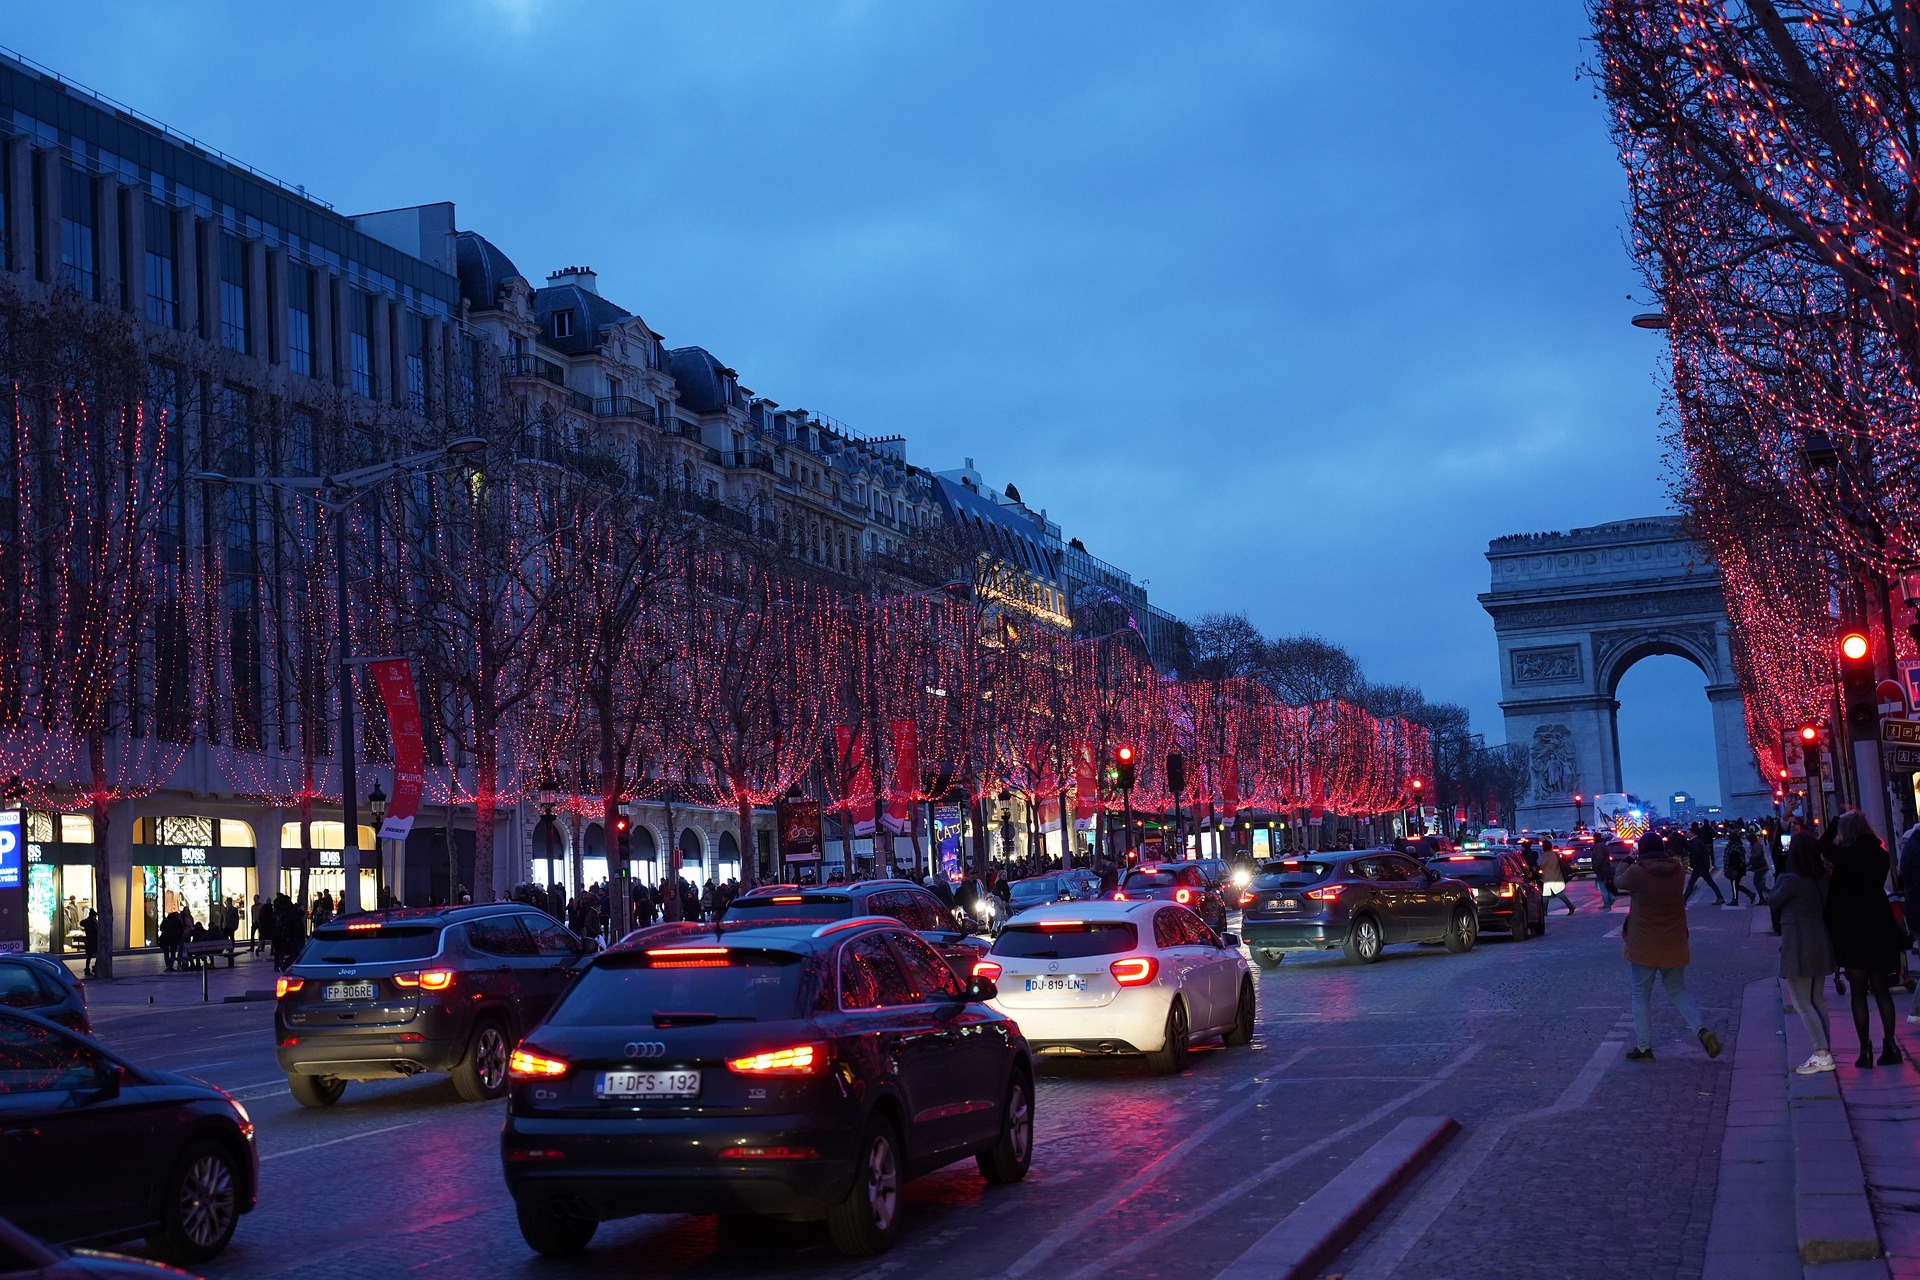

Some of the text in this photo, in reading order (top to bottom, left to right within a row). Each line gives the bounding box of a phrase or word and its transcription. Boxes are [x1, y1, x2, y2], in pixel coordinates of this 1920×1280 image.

[936, 824, 961, 842] CATS
[27, 844, 42, 858] SS
[182, 848, 206, 860] BOSS
[320, 851, 340, 862] BOSS
